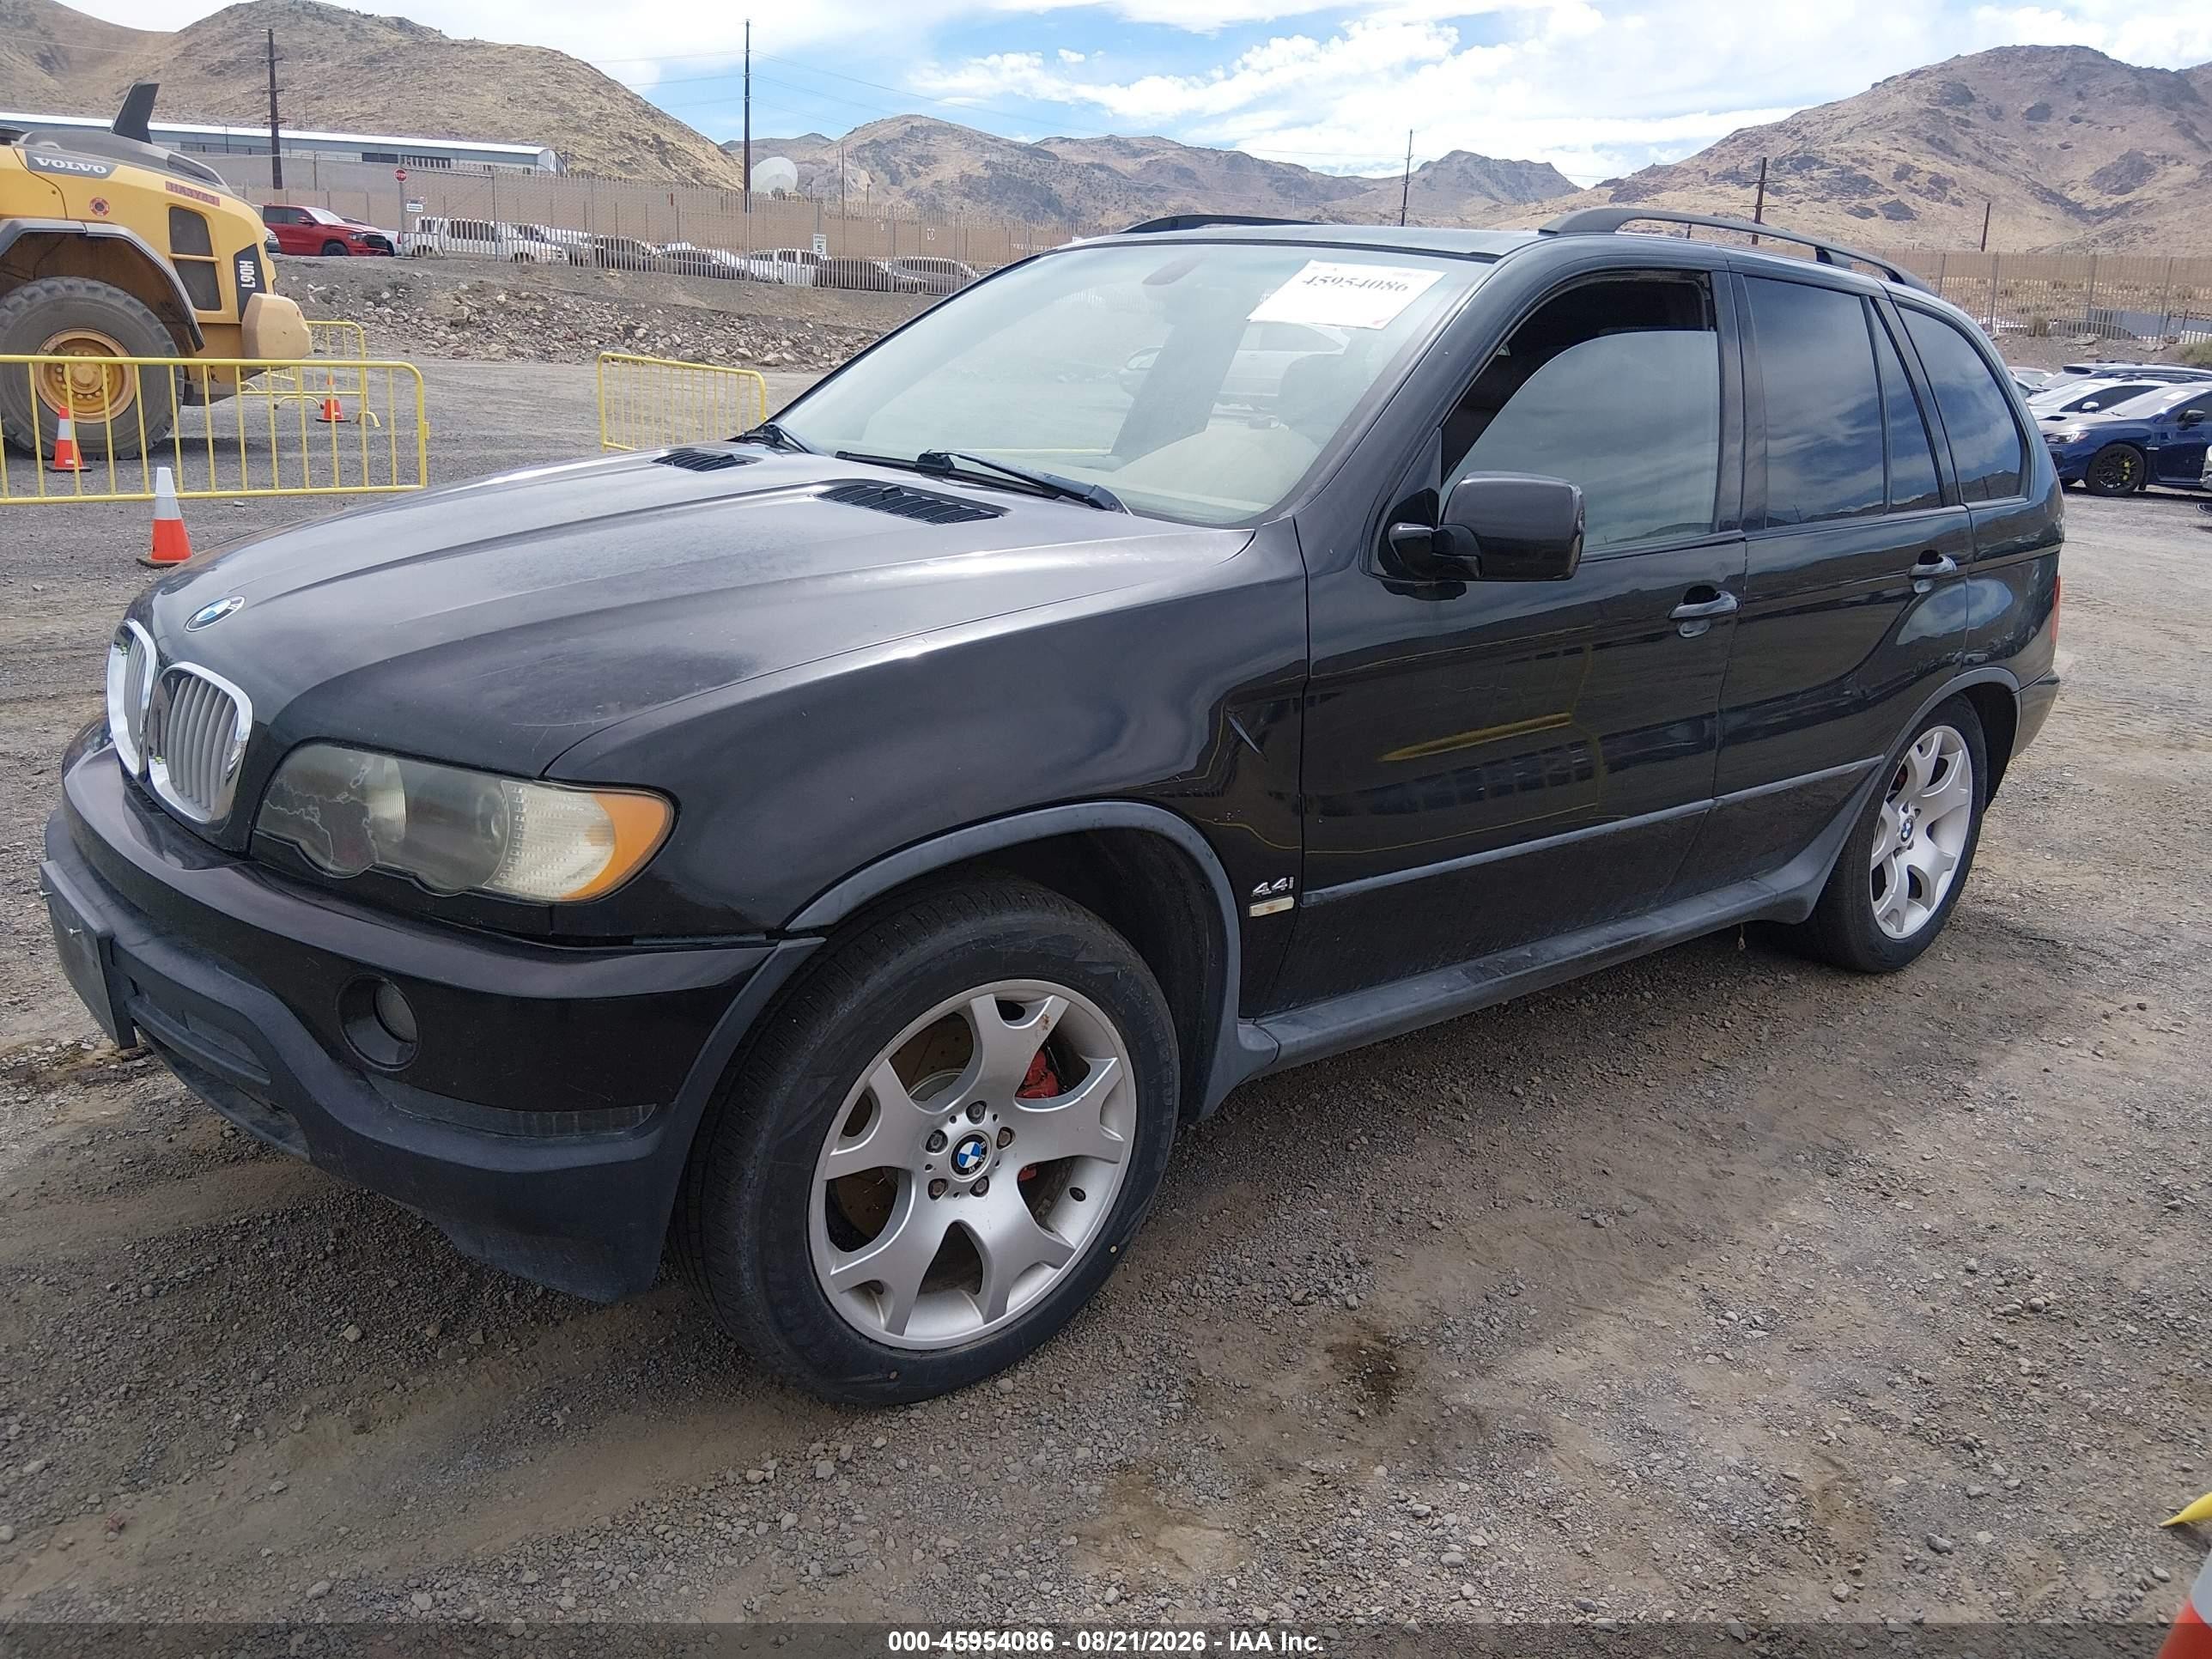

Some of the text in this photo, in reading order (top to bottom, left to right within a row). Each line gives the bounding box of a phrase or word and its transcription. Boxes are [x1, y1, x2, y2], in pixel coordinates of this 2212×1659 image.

[33, 156, 107, 173] VOLVO
[817, 245, 823, 253] 5
[239, 260, 256, 289] L90H
